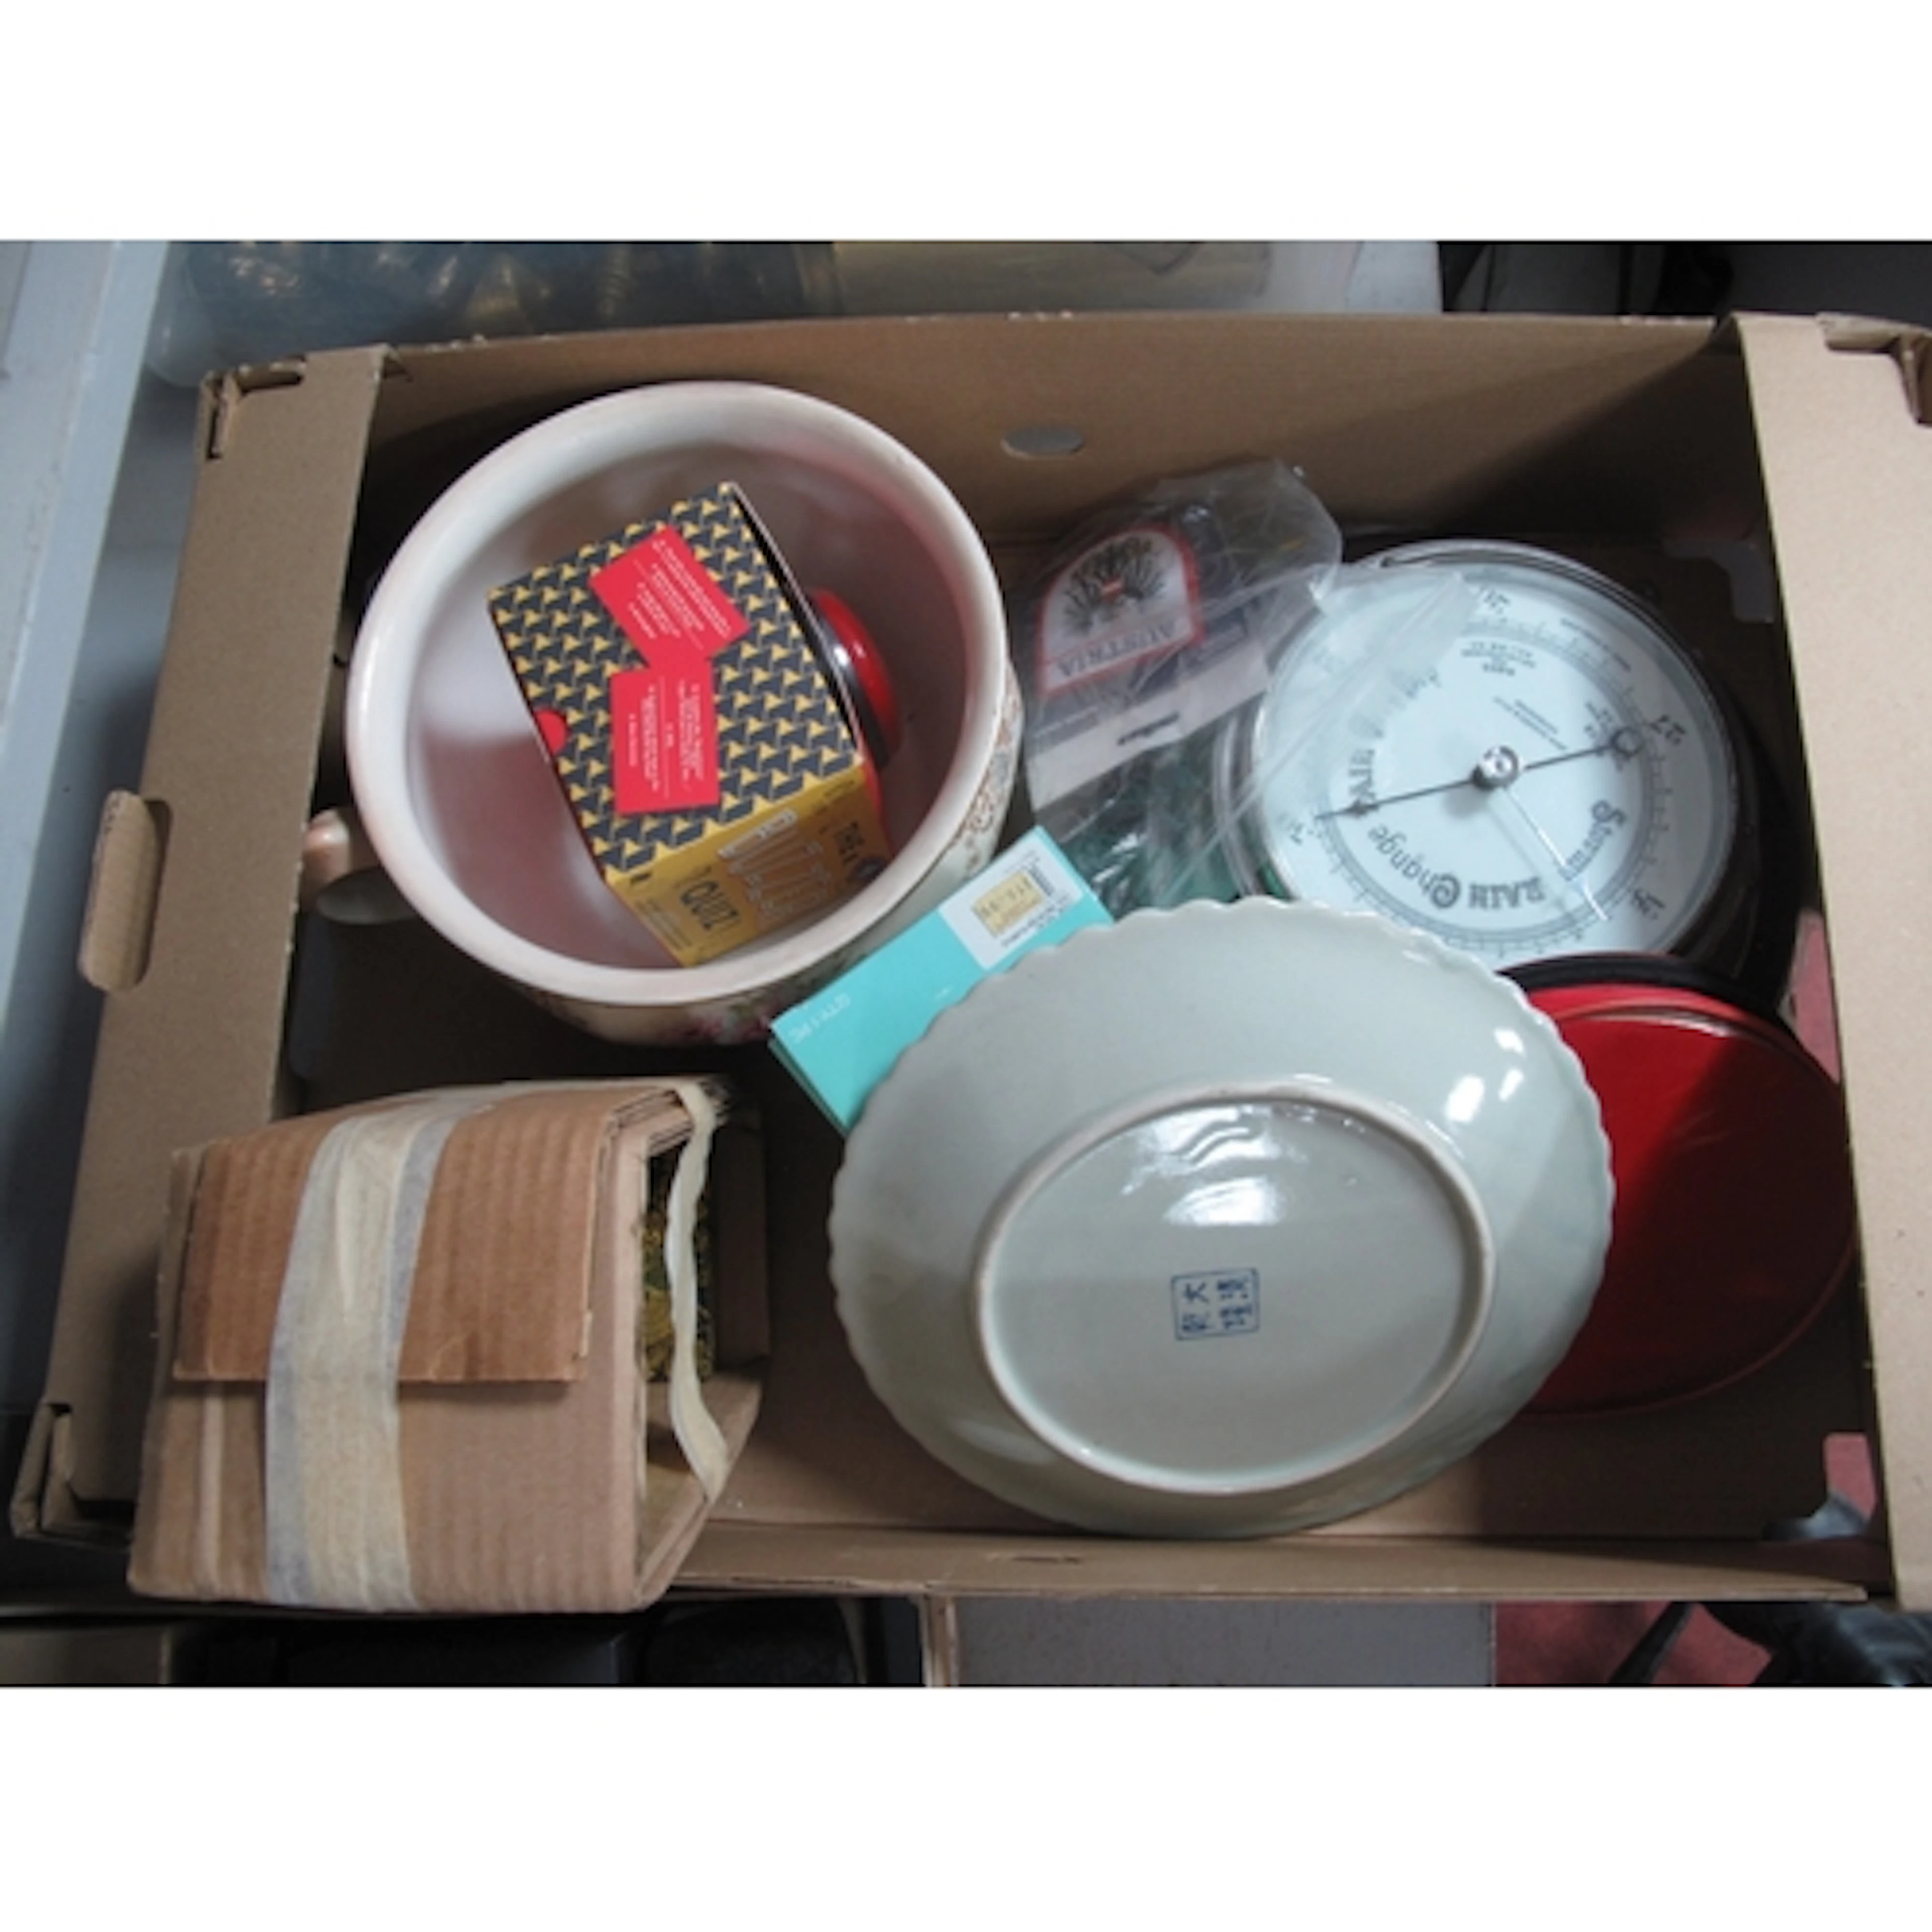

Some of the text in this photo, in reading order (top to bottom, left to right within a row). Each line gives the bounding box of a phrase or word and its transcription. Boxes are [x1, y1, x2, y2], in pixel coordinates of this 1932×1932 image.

[1058, 620, 1175, 677] AUSTRIA
[1368, 823, 1461, 910] Change
[1468, 876, 1545, 910] RAIN
